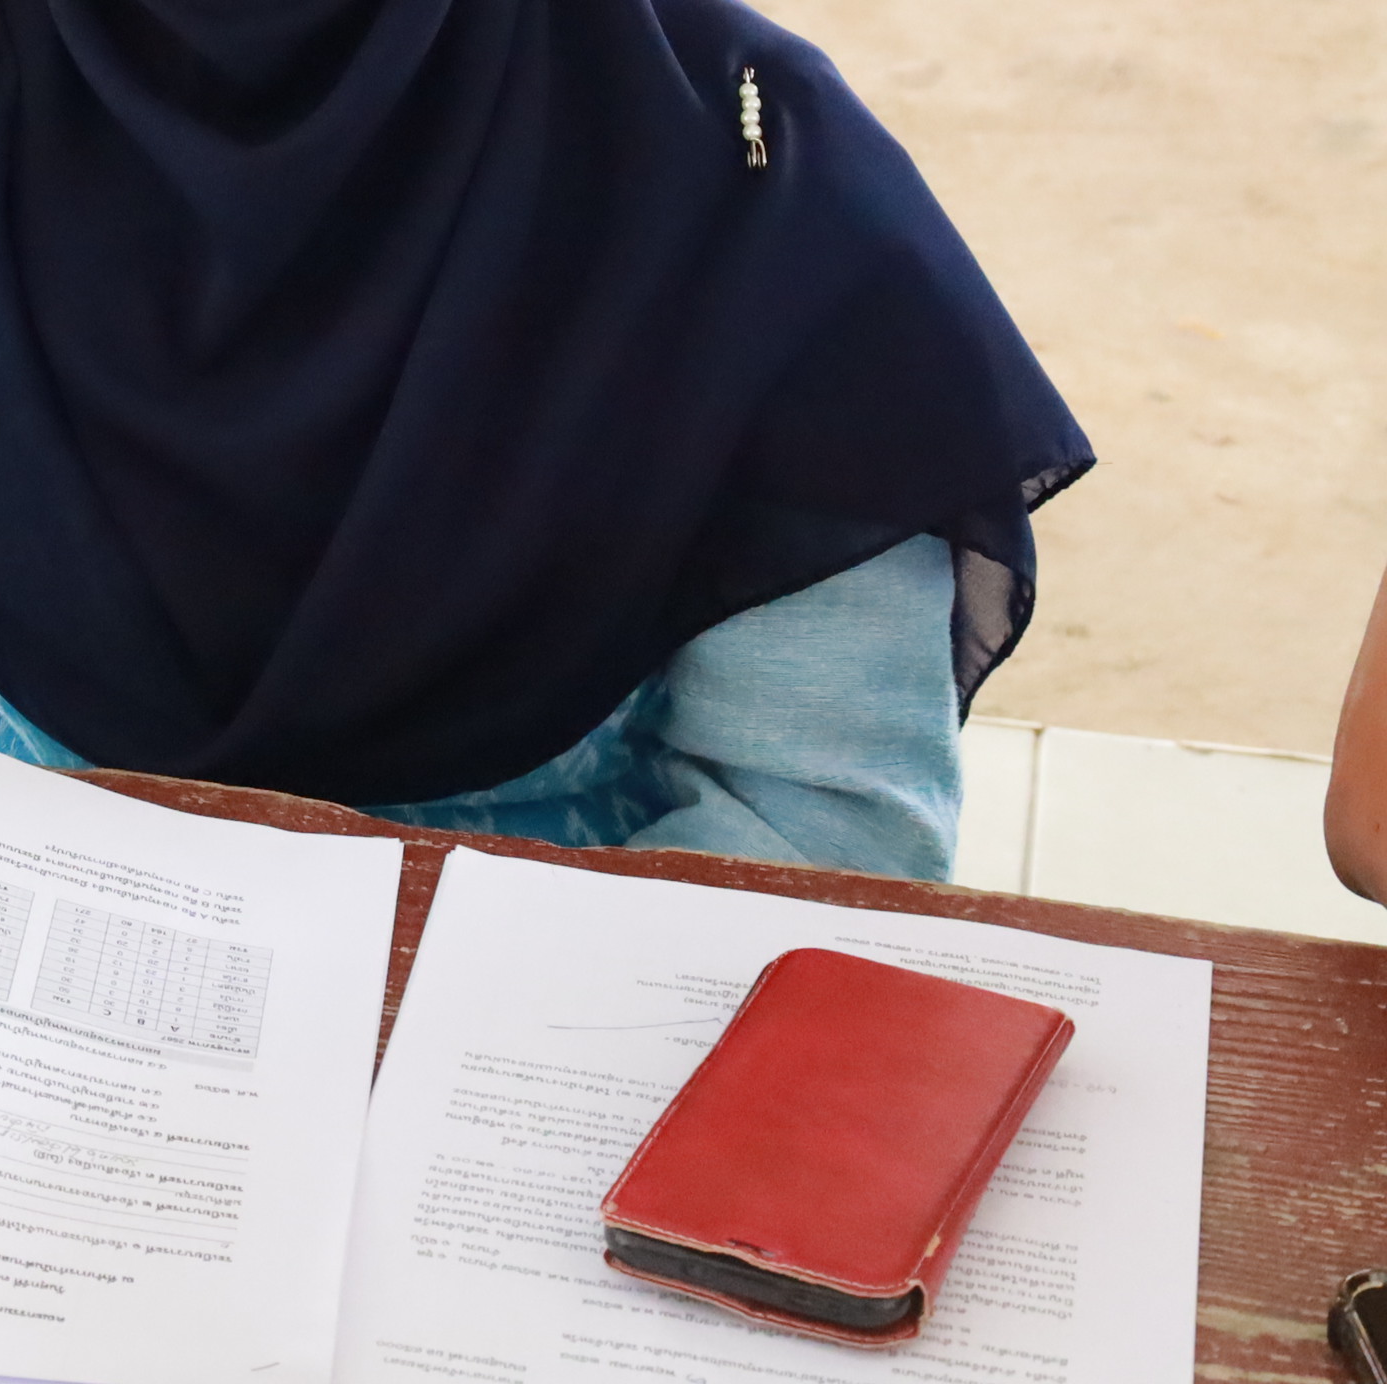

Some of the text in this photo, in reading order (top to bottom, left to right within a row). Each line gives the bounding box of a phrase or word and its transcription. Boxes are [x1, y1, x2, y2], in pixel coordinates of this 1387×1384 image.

[216, 891, 245, 903] ระดับ
[214, 903, 242, 915] ระดับ
[212, 915, 240, 927] ระดับ
[69, 1114, 149, 1139] เรื่องเพื่อทราบ
[167, 1134, 249, 1152] ระเบียบวาระที่
[159, 1175, 243, 1193] ระเบียบวาระที่
[175, 1191, 242, 1208] มติที่ประชุม
[156, 1203, 238, 1221] ระเบียบวาระที่
[146, 1245, 232, 1264] ระเบียบวาระที่
[14, 1277, 65, 1295] วันศุกร์ที่
